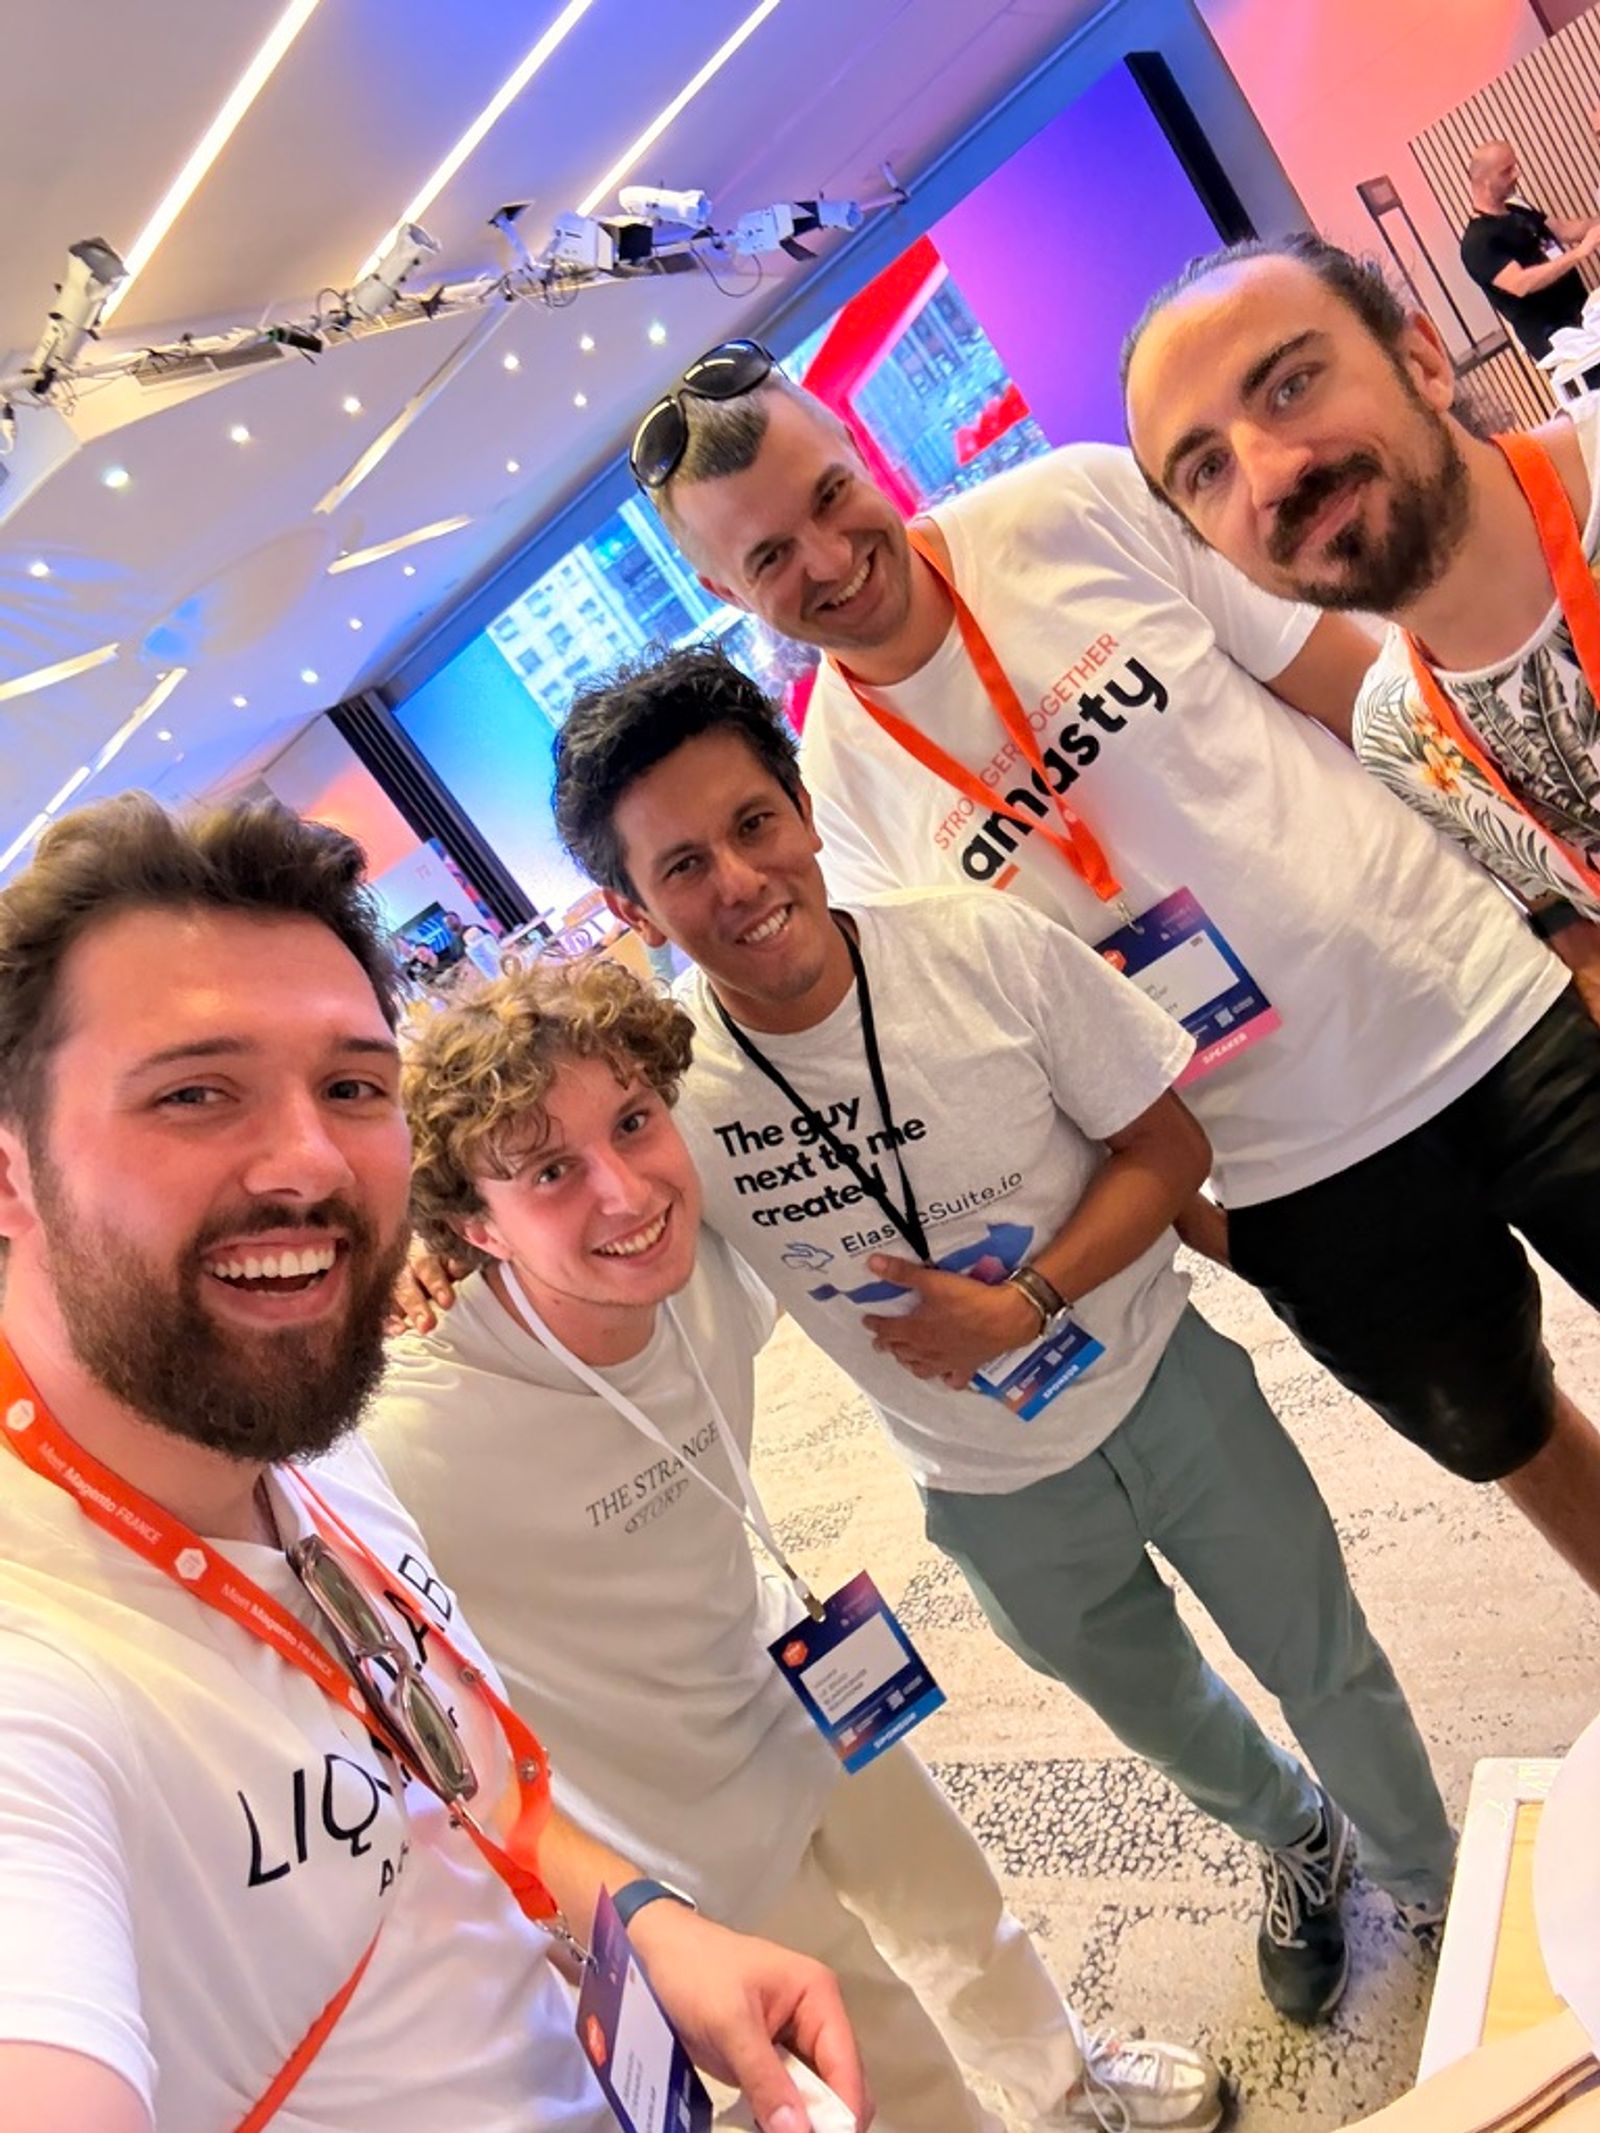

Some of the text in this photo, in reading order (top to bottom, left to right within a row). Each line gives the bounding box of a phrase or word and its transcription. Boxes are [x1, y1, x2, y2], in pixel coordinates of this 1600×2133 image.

[933, 632, 1120, 850] STROGER OGETHER
[961, 656, 1170, 881] amasty
[713, 1096, 860, 1158] The guy
[733, 1118, 927, 1195] next to me
[751, 1162, 888, 1226] created
[840, 1171, 1023, 1253] ElascSuite.io
[585, 1420, 720, 1528] THE STRANGE
